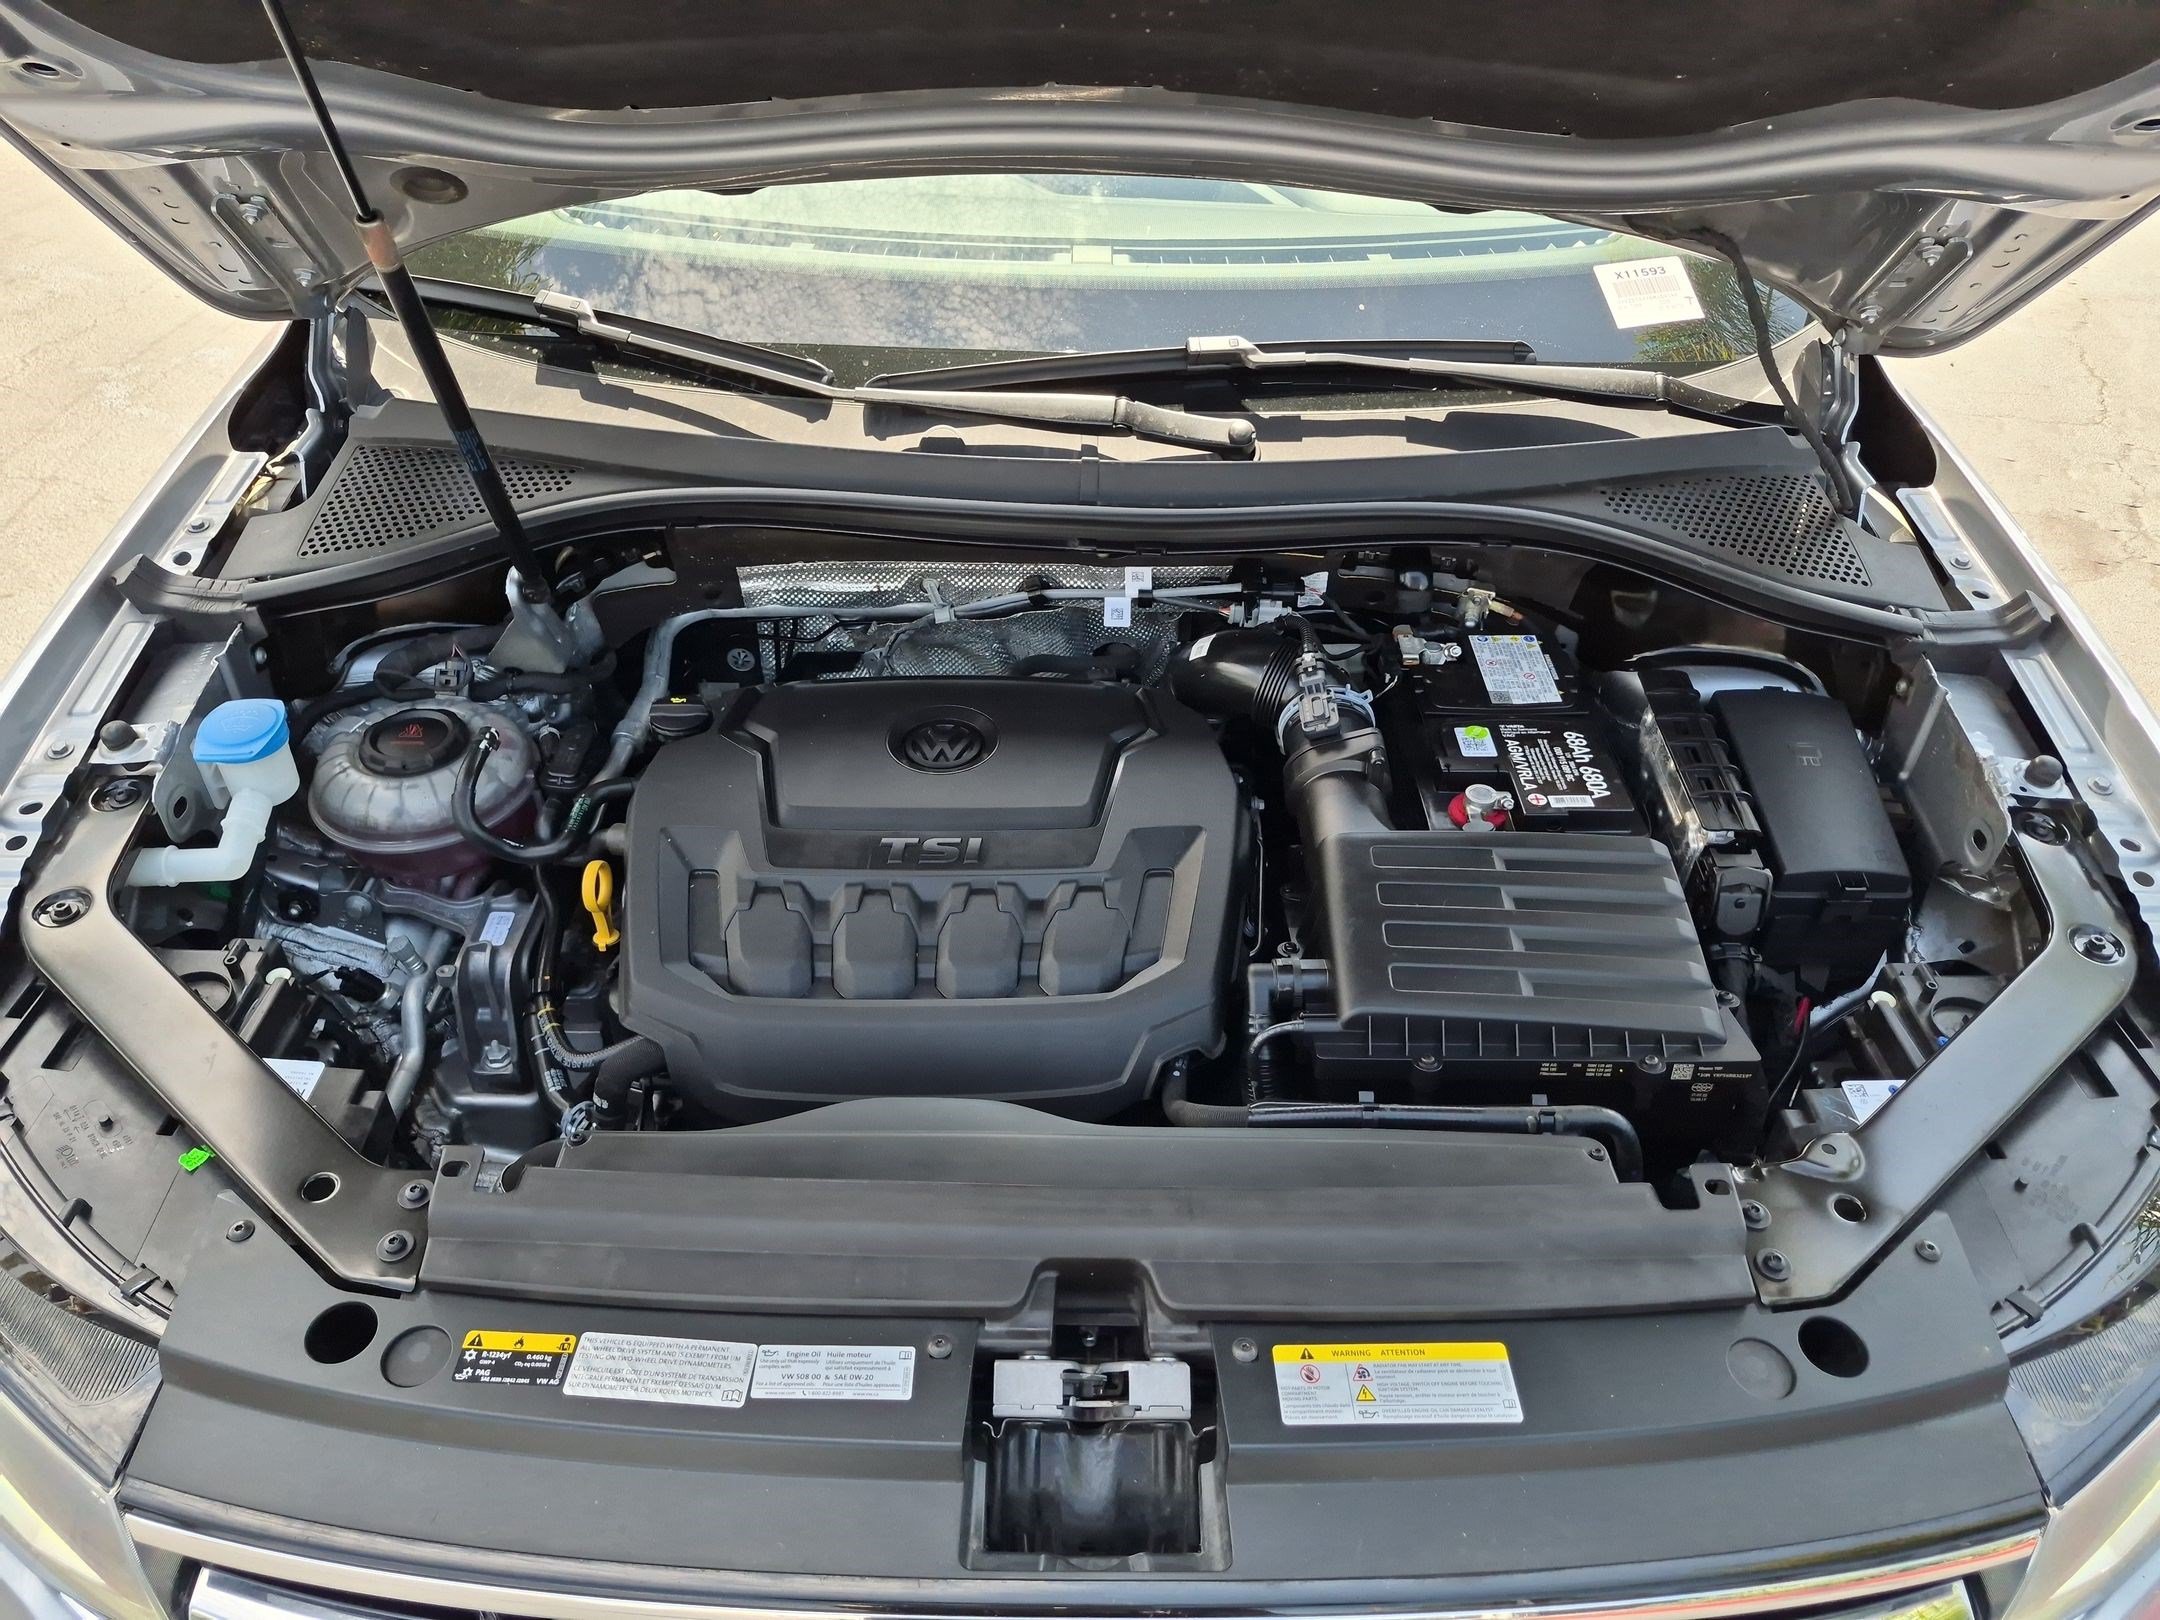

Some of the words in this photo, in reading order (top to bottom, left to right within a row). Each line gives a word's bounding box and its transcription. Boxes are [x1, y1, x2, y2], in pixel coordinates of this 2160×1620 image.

[1614, 266, 1666, 280] X11593
[1504, 739, 1538, 790] AGM/VRLA
[1563, 732, 1594, 762] 68Ah
[1579, 766, 1611, 798] 680A
[880, 837, 982, 864] TSI
[690, 1344, 730, 1352] PERMANENT
[480, 1351, 512, 1360] R-1234yf
[697, 1374, 744, 1382] TRANSMISSION
